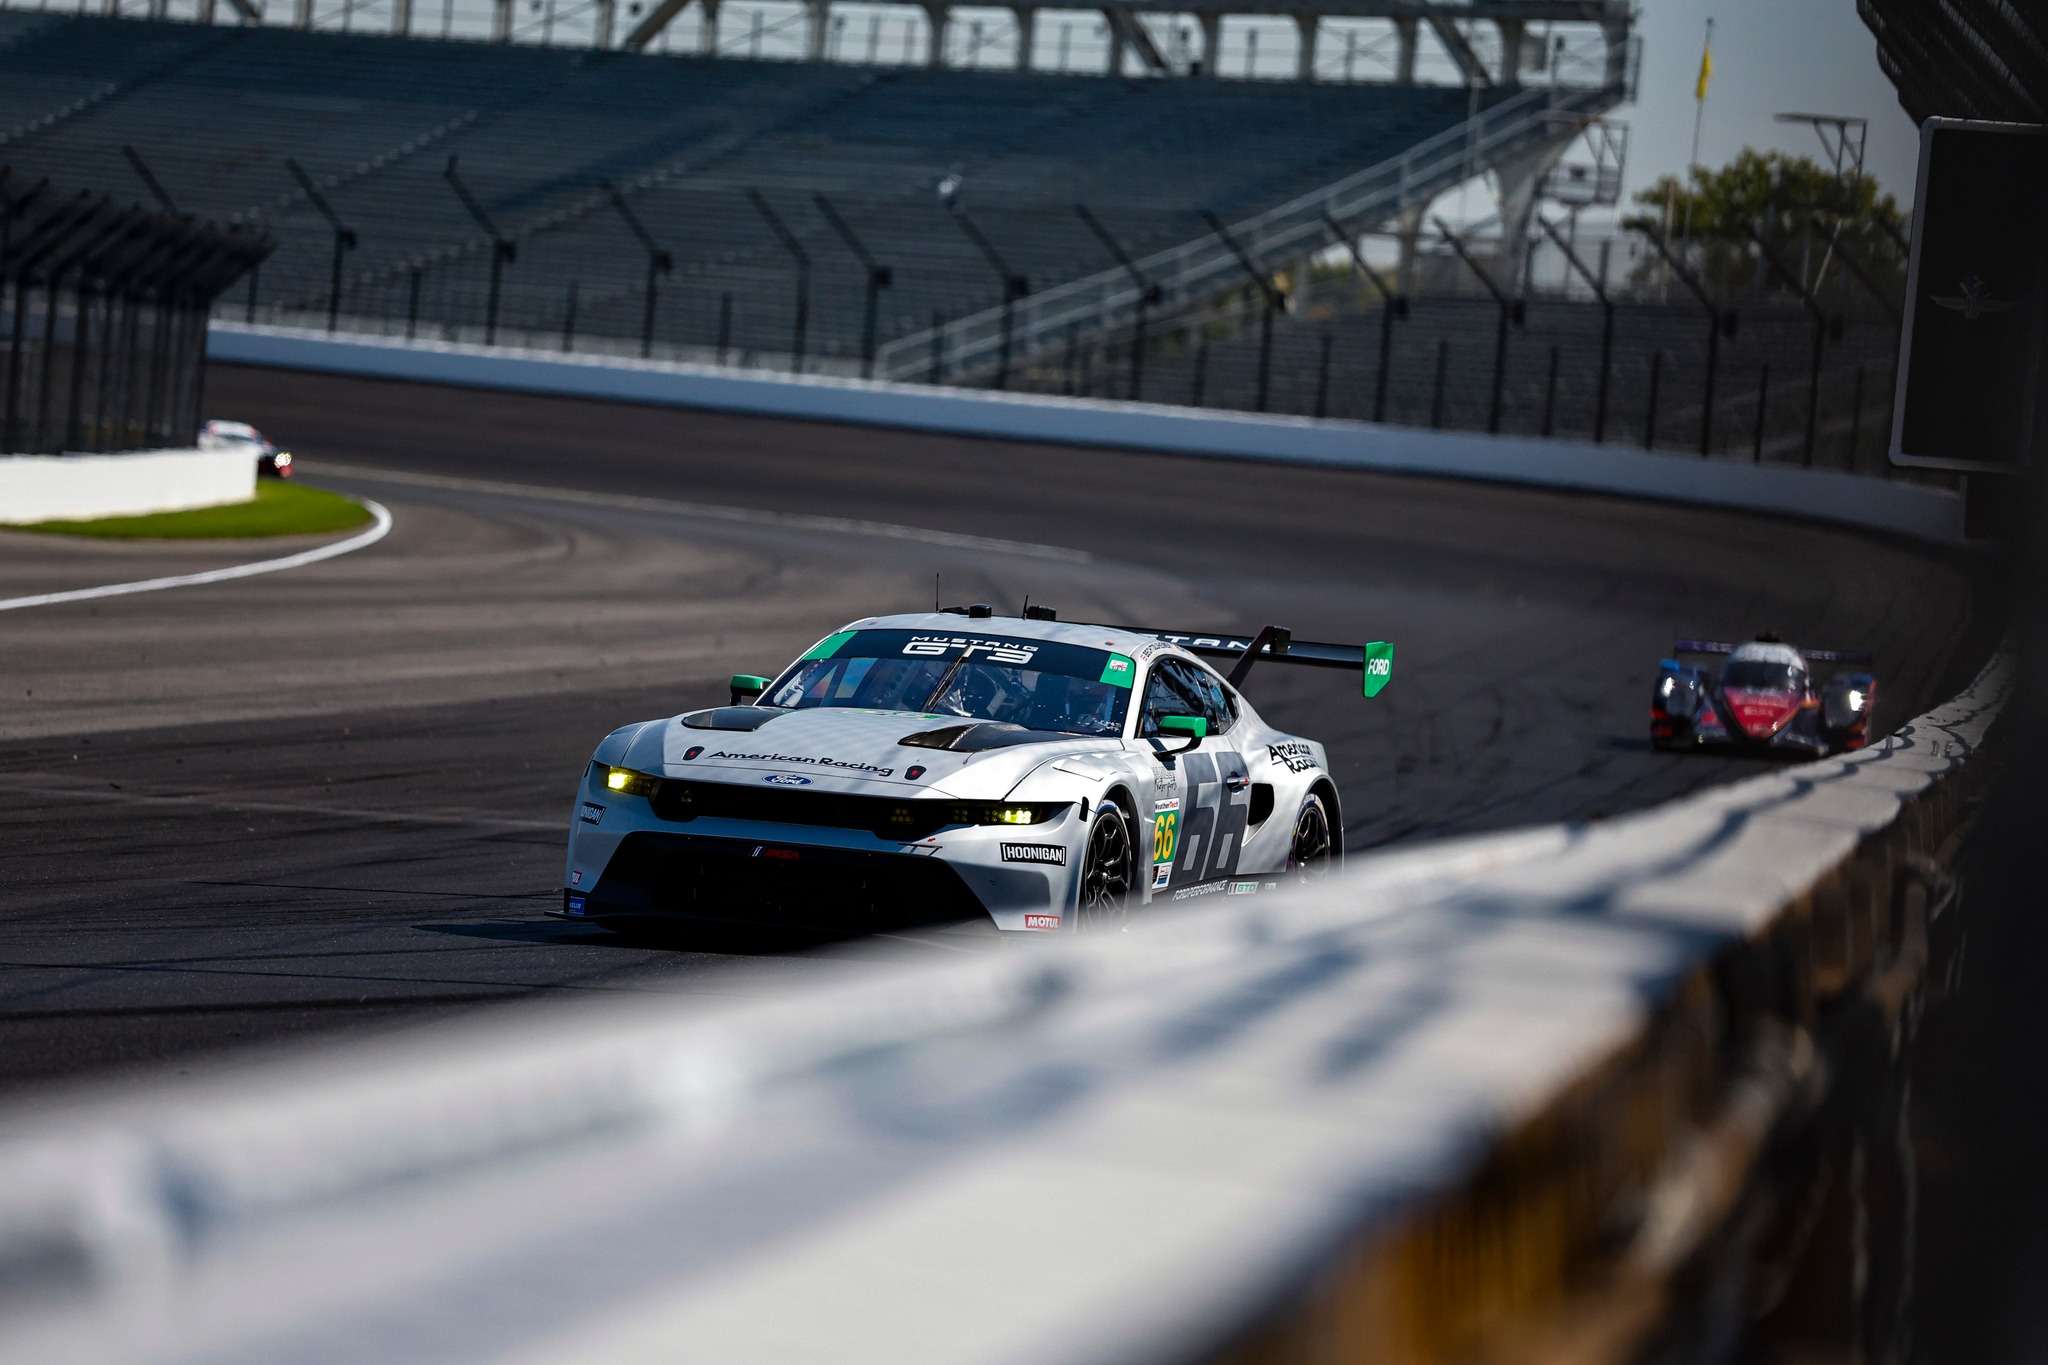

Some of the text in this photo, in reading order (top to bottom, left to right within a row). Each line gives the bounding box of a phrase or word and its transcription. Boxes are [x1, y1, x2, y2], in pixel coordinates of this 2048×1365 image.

[902, 641, 1033, 665] GT3
[911, 636, 1039, 652] MUSTANG
[1367, 658, 1390, 676] FORD
[708, 751, 894, 776] American Racing
[771, 775, 804, 785] Ford
[1171, 752, 1250, 882] 66
[1153, 813, 1175, 861] 66
[1027, 916, 1059, 928] MOTUL
